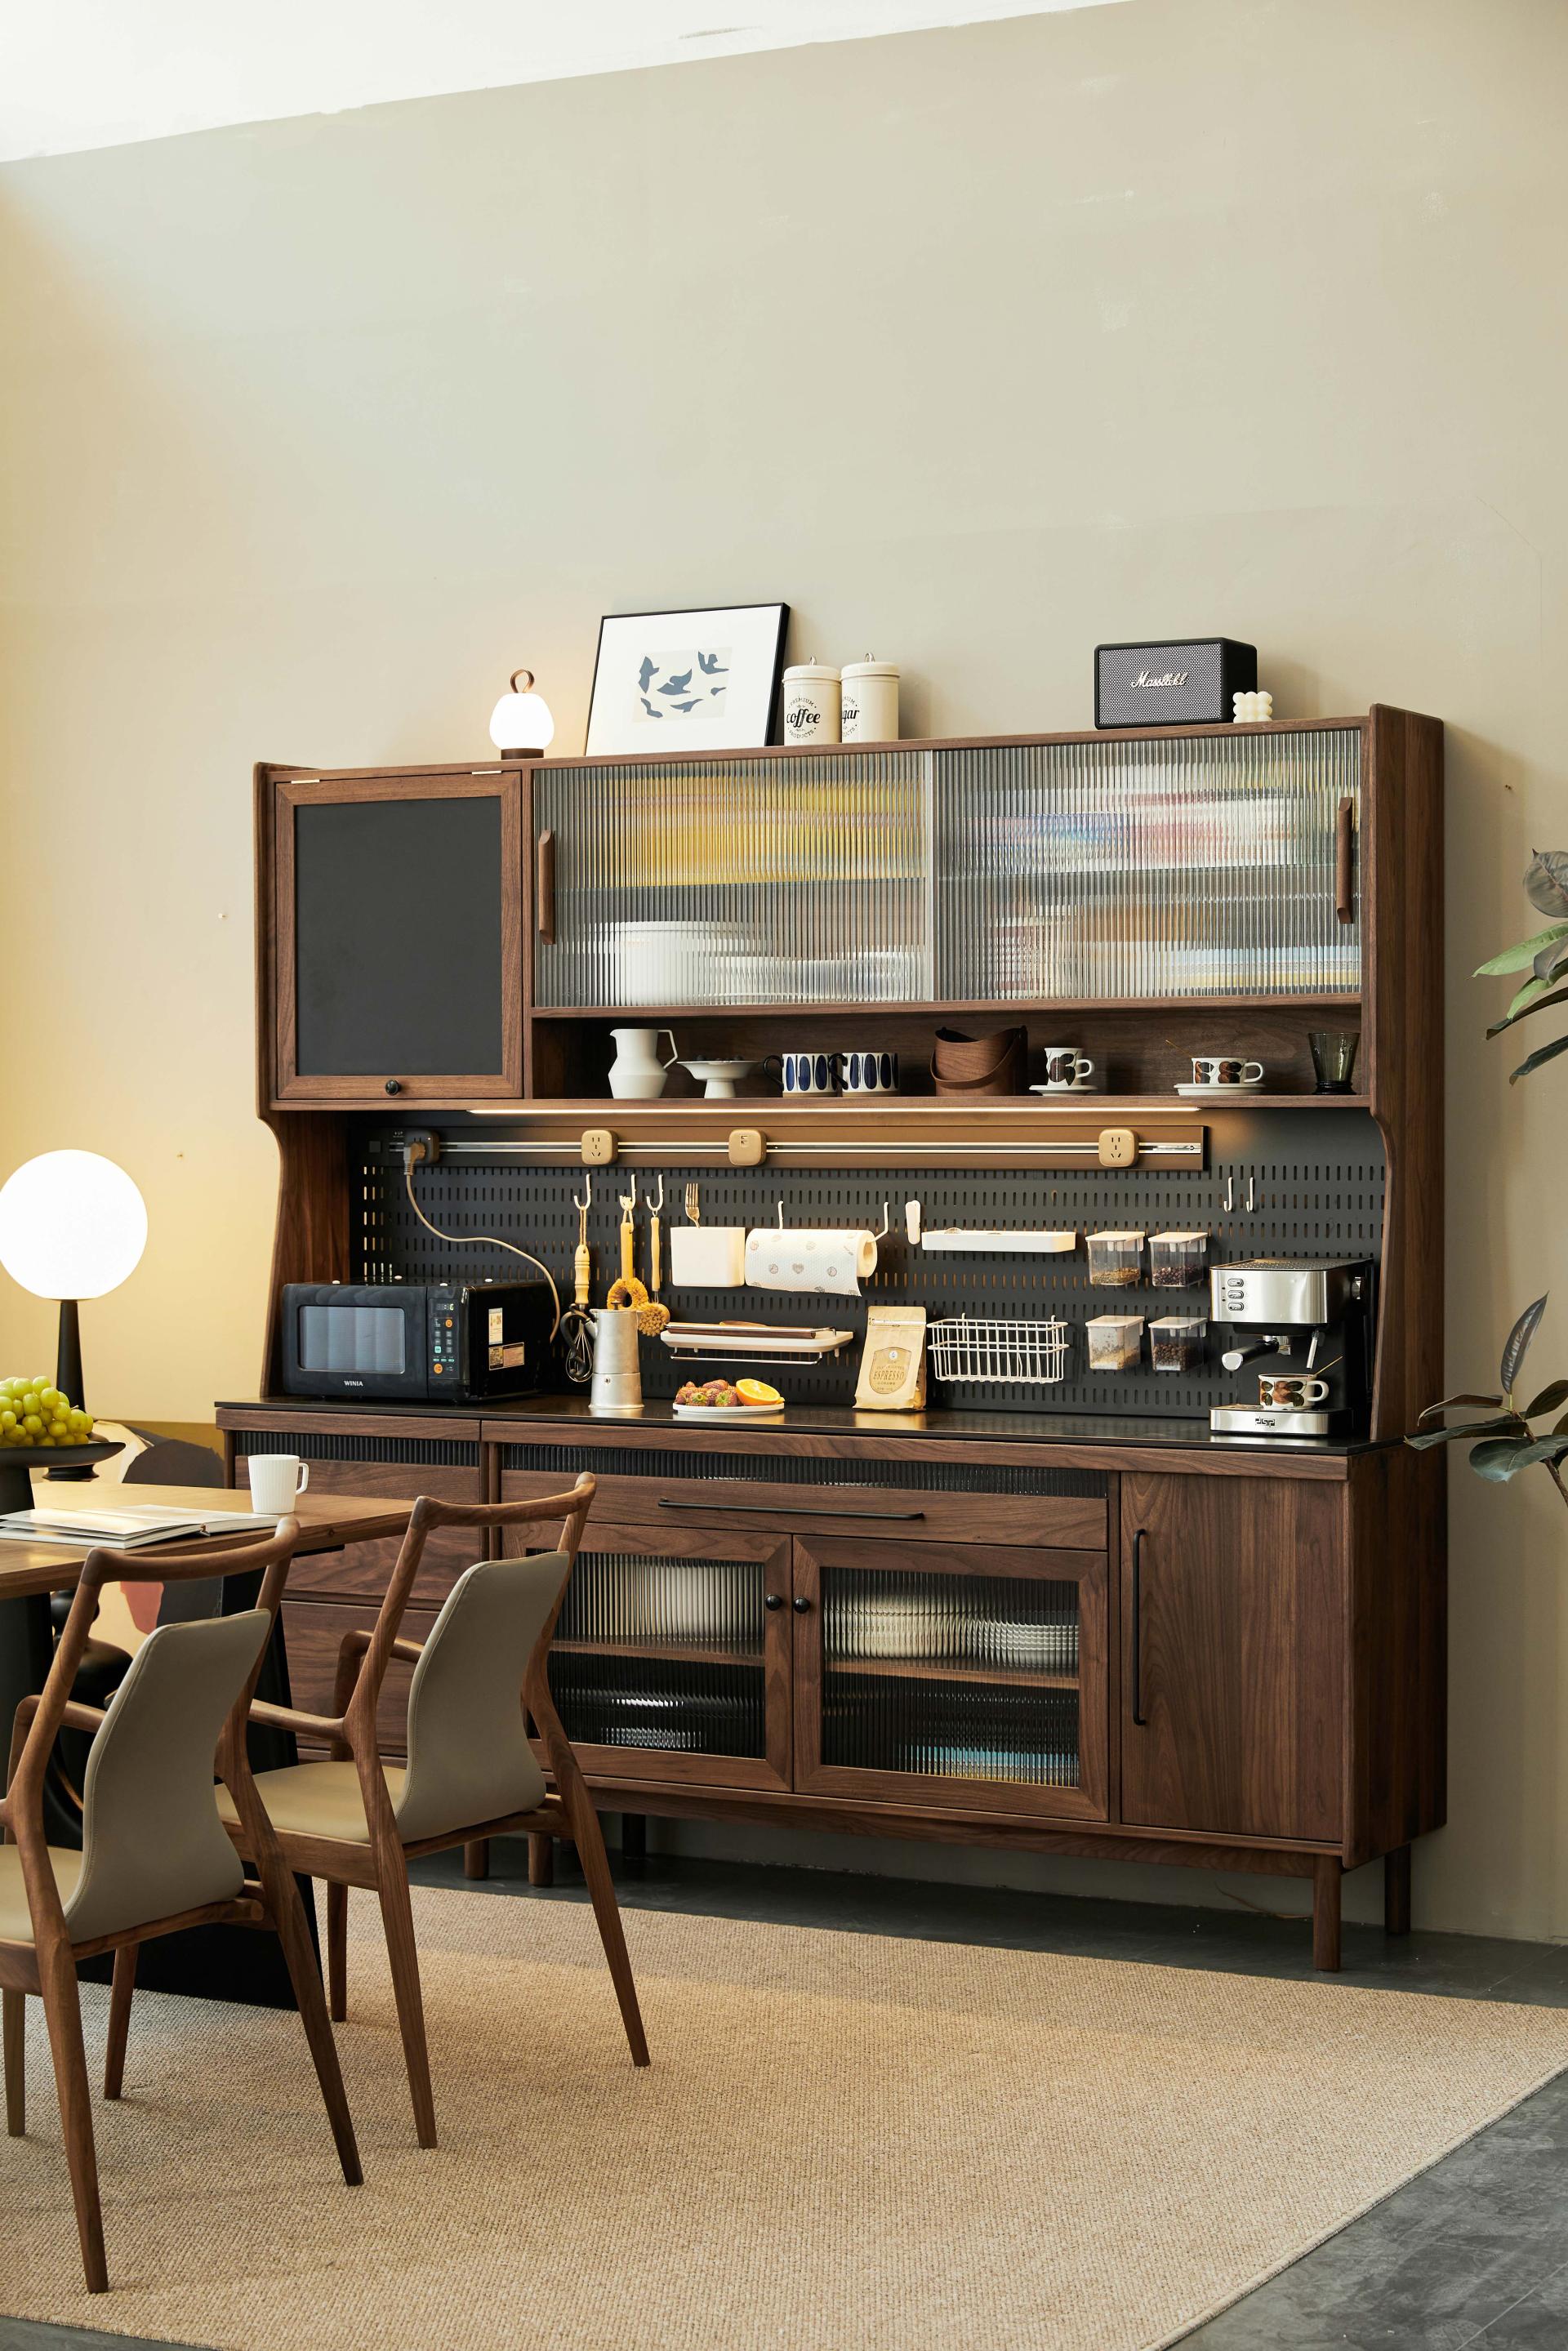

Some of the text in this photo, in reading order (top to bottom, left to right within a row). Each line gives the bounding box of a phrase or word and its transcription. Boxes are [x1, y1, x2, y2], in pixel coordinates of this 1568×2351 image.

[790, 697, 814, 706] PREMIUM
[786, 708, 821, 728] coffee
[842, 710, 860, 724] gar
[789, 729, 814, 739] PRODUCTS
[873, 1370, 905, 1380] ESPRESSO
